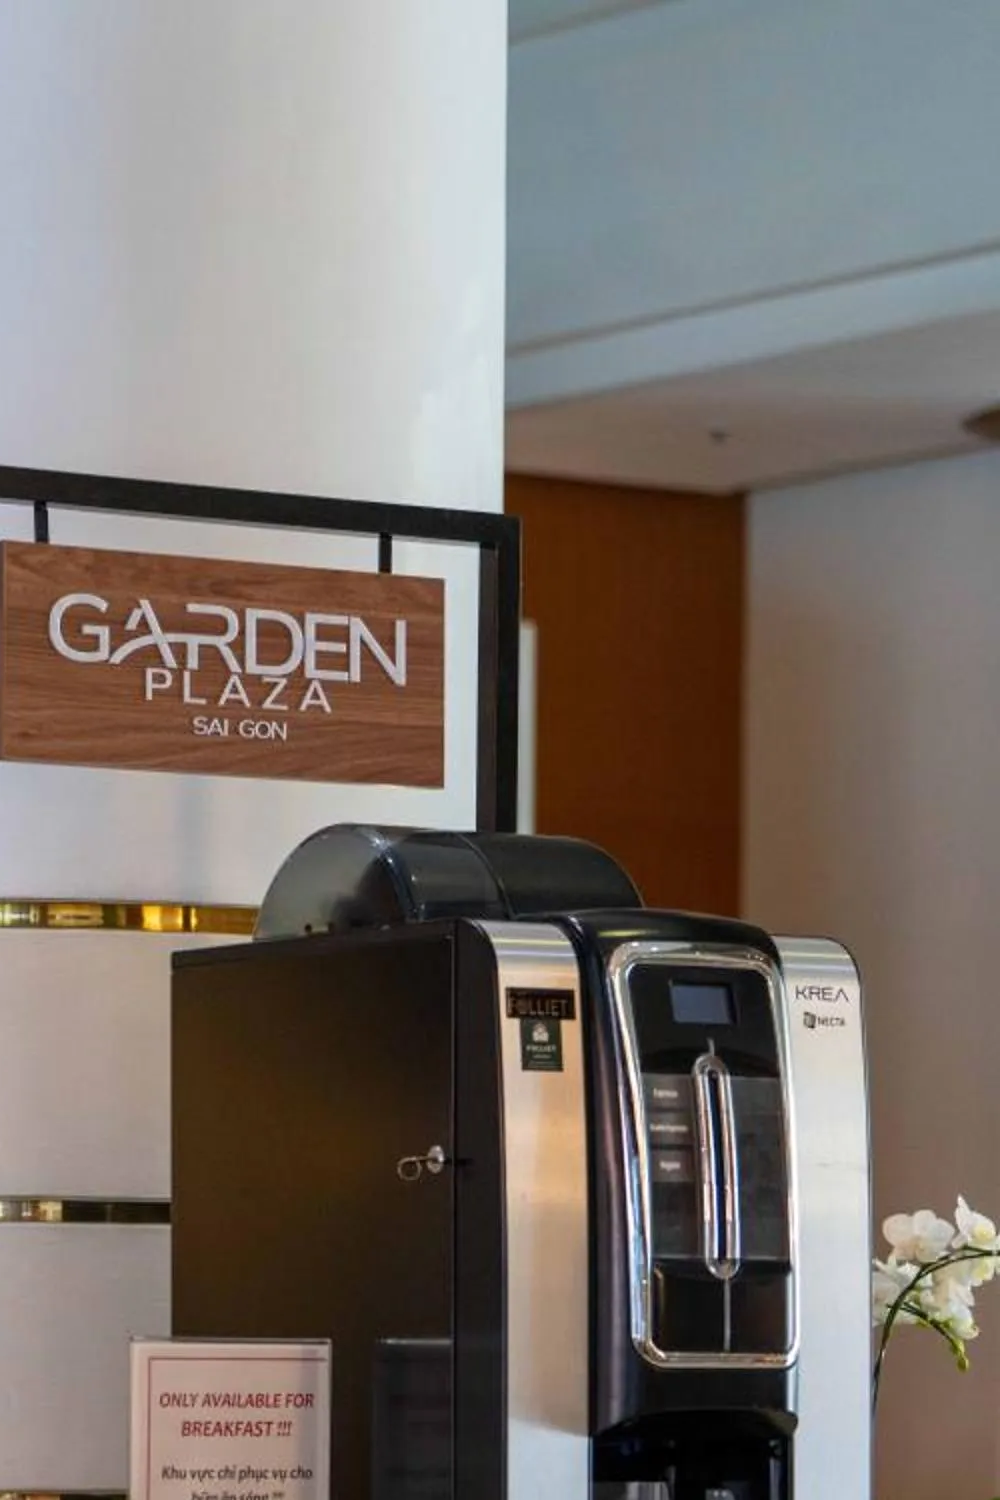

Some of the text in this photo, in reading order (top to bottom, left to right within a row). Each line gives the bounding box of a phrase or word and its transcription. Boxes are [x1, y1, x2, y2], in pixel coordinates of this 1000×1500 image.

[48, 593, 407, 686] GARDEN
[145, 667, 332, 713] PLAZA
[192, 716, 288, 741] SAI GON
[795, 985, 849, 1002] KREA
[159, 1392, 315, 1408] ONLY AVAILABLE FOR
[181, 1420, 274, 1437] BREAKFAST
[161, 1464, 187, 1480] Khu
[290, 1465, 313, 1480] cho
